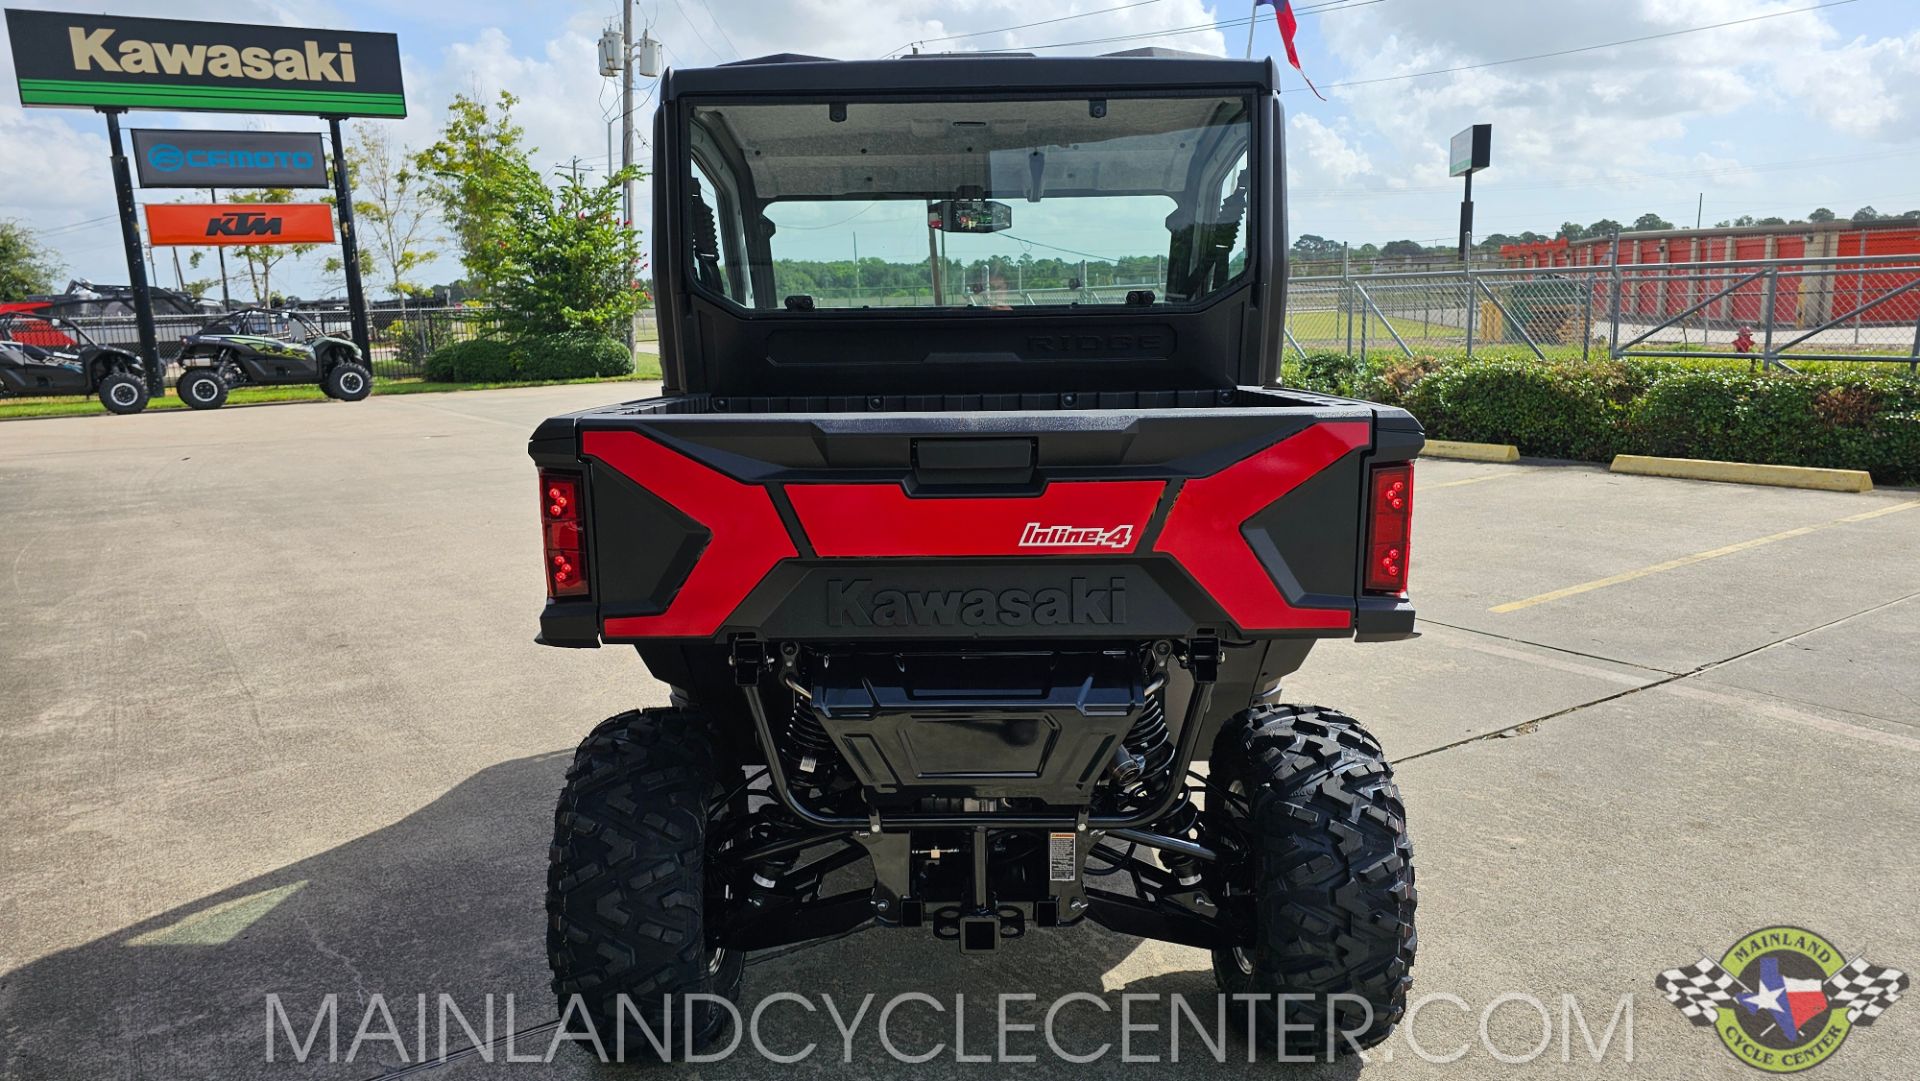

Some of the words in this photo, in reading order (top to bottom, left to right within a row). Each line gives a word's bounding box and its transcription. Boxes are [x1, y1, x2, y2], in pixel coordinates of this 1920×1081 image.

[68, 26, 356, 83] Kawasaki
[186, 150, 314, 170] CFMOTO
[205, 212, 282, 236] KTM
[1025, 335, 1162, 353] RIDGE
[1018, 522, 1134, 548] Inline-4
[826, 576, 1127, 627] Kawasaki
